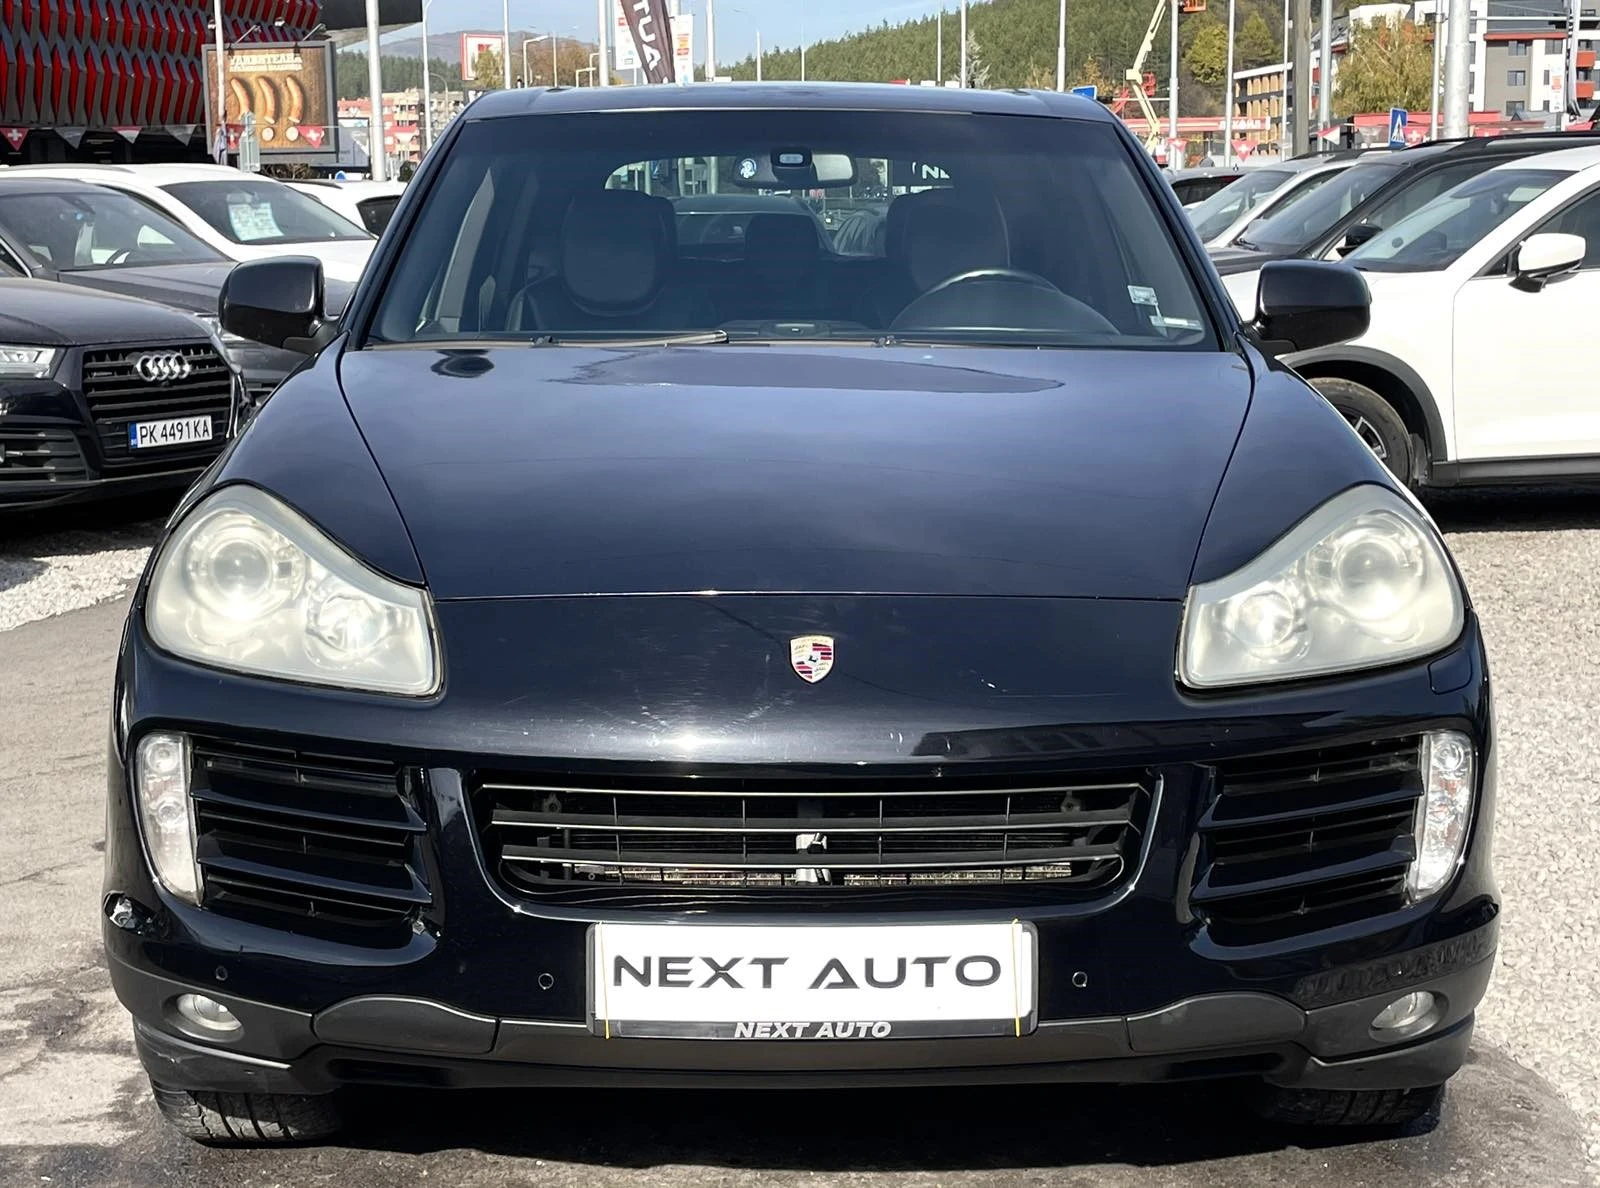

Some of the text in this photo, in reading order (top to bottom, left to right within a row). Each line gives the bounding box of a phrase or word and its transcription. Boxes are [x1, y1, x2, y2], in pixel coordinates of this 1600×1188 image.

[160, 422, 191, 441] 4491
[613, 954, 1001, 989] NEXT AUTO
[734, 1021, 892, 1038] NEXT AUTO
